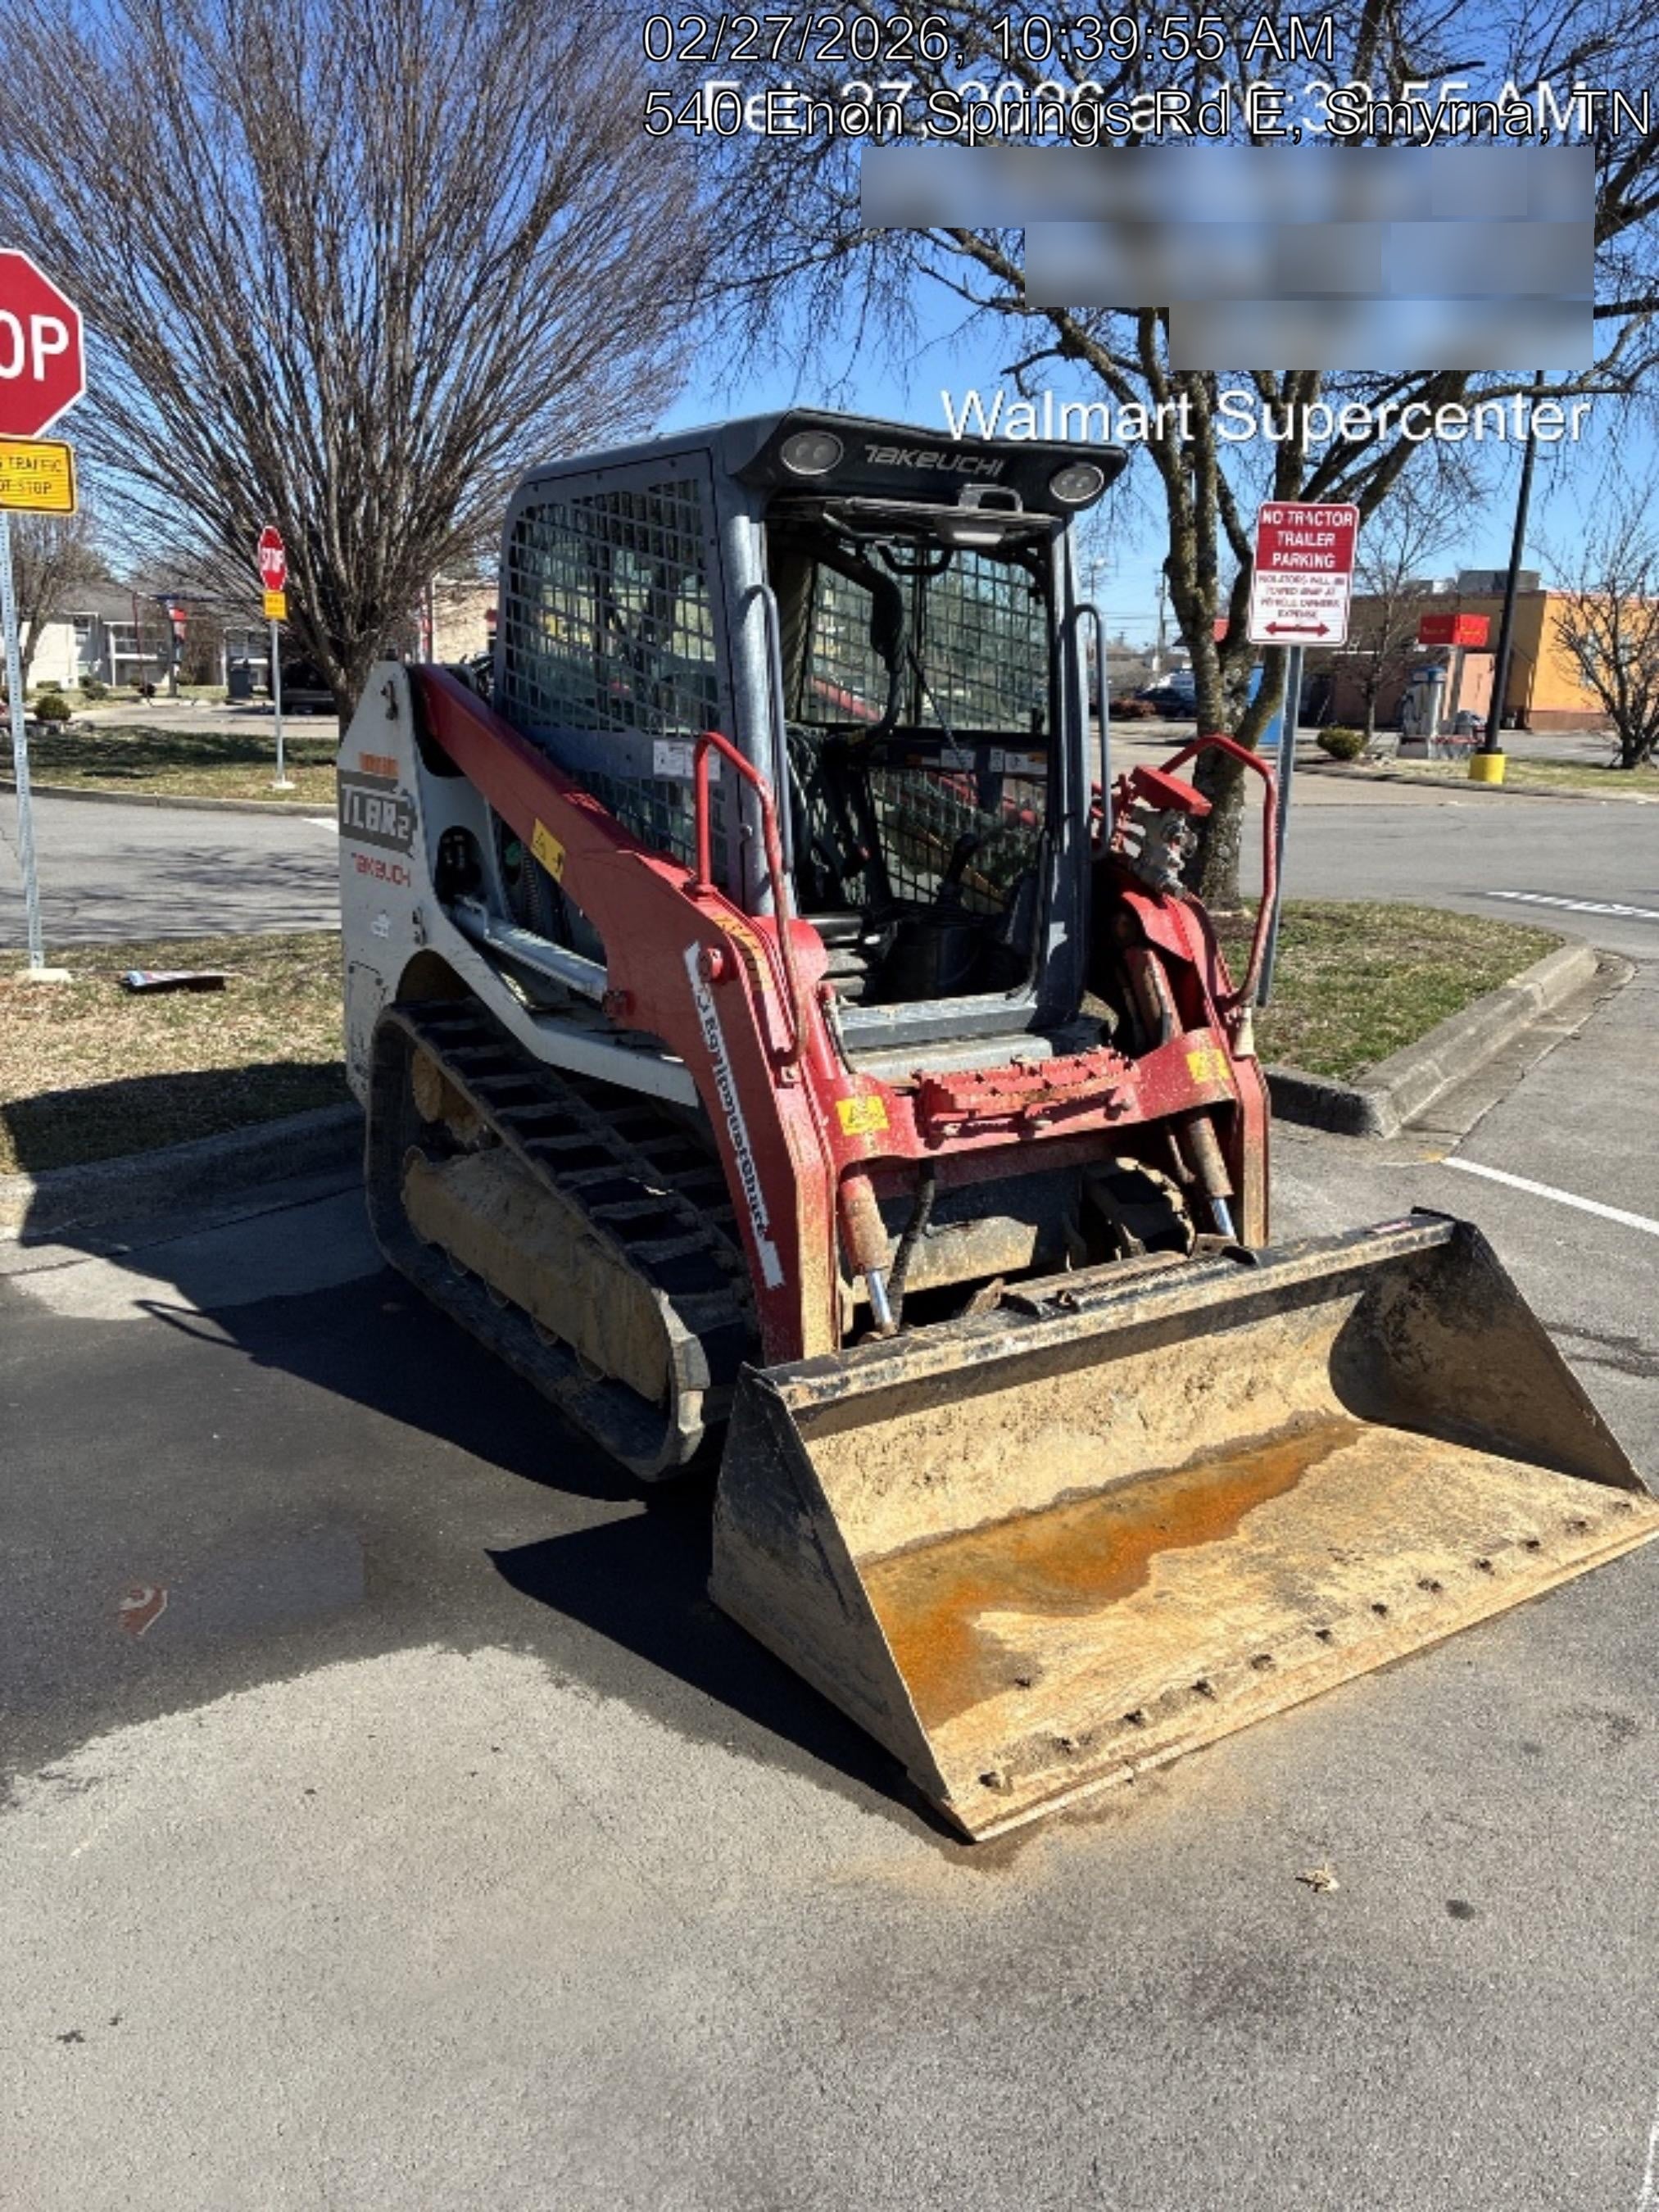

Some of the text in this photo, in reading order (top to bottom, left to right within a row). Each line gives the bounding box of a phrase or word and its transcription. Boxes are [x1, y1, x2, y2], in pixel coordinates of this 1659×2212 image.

[1262, 511, 1353, 527] NO TRACTOR
[1276, 531, 1335, 546] TRAILER
[263, 546, 285, 573] STOP
[1271, 552, 1336, 569] PARKING
